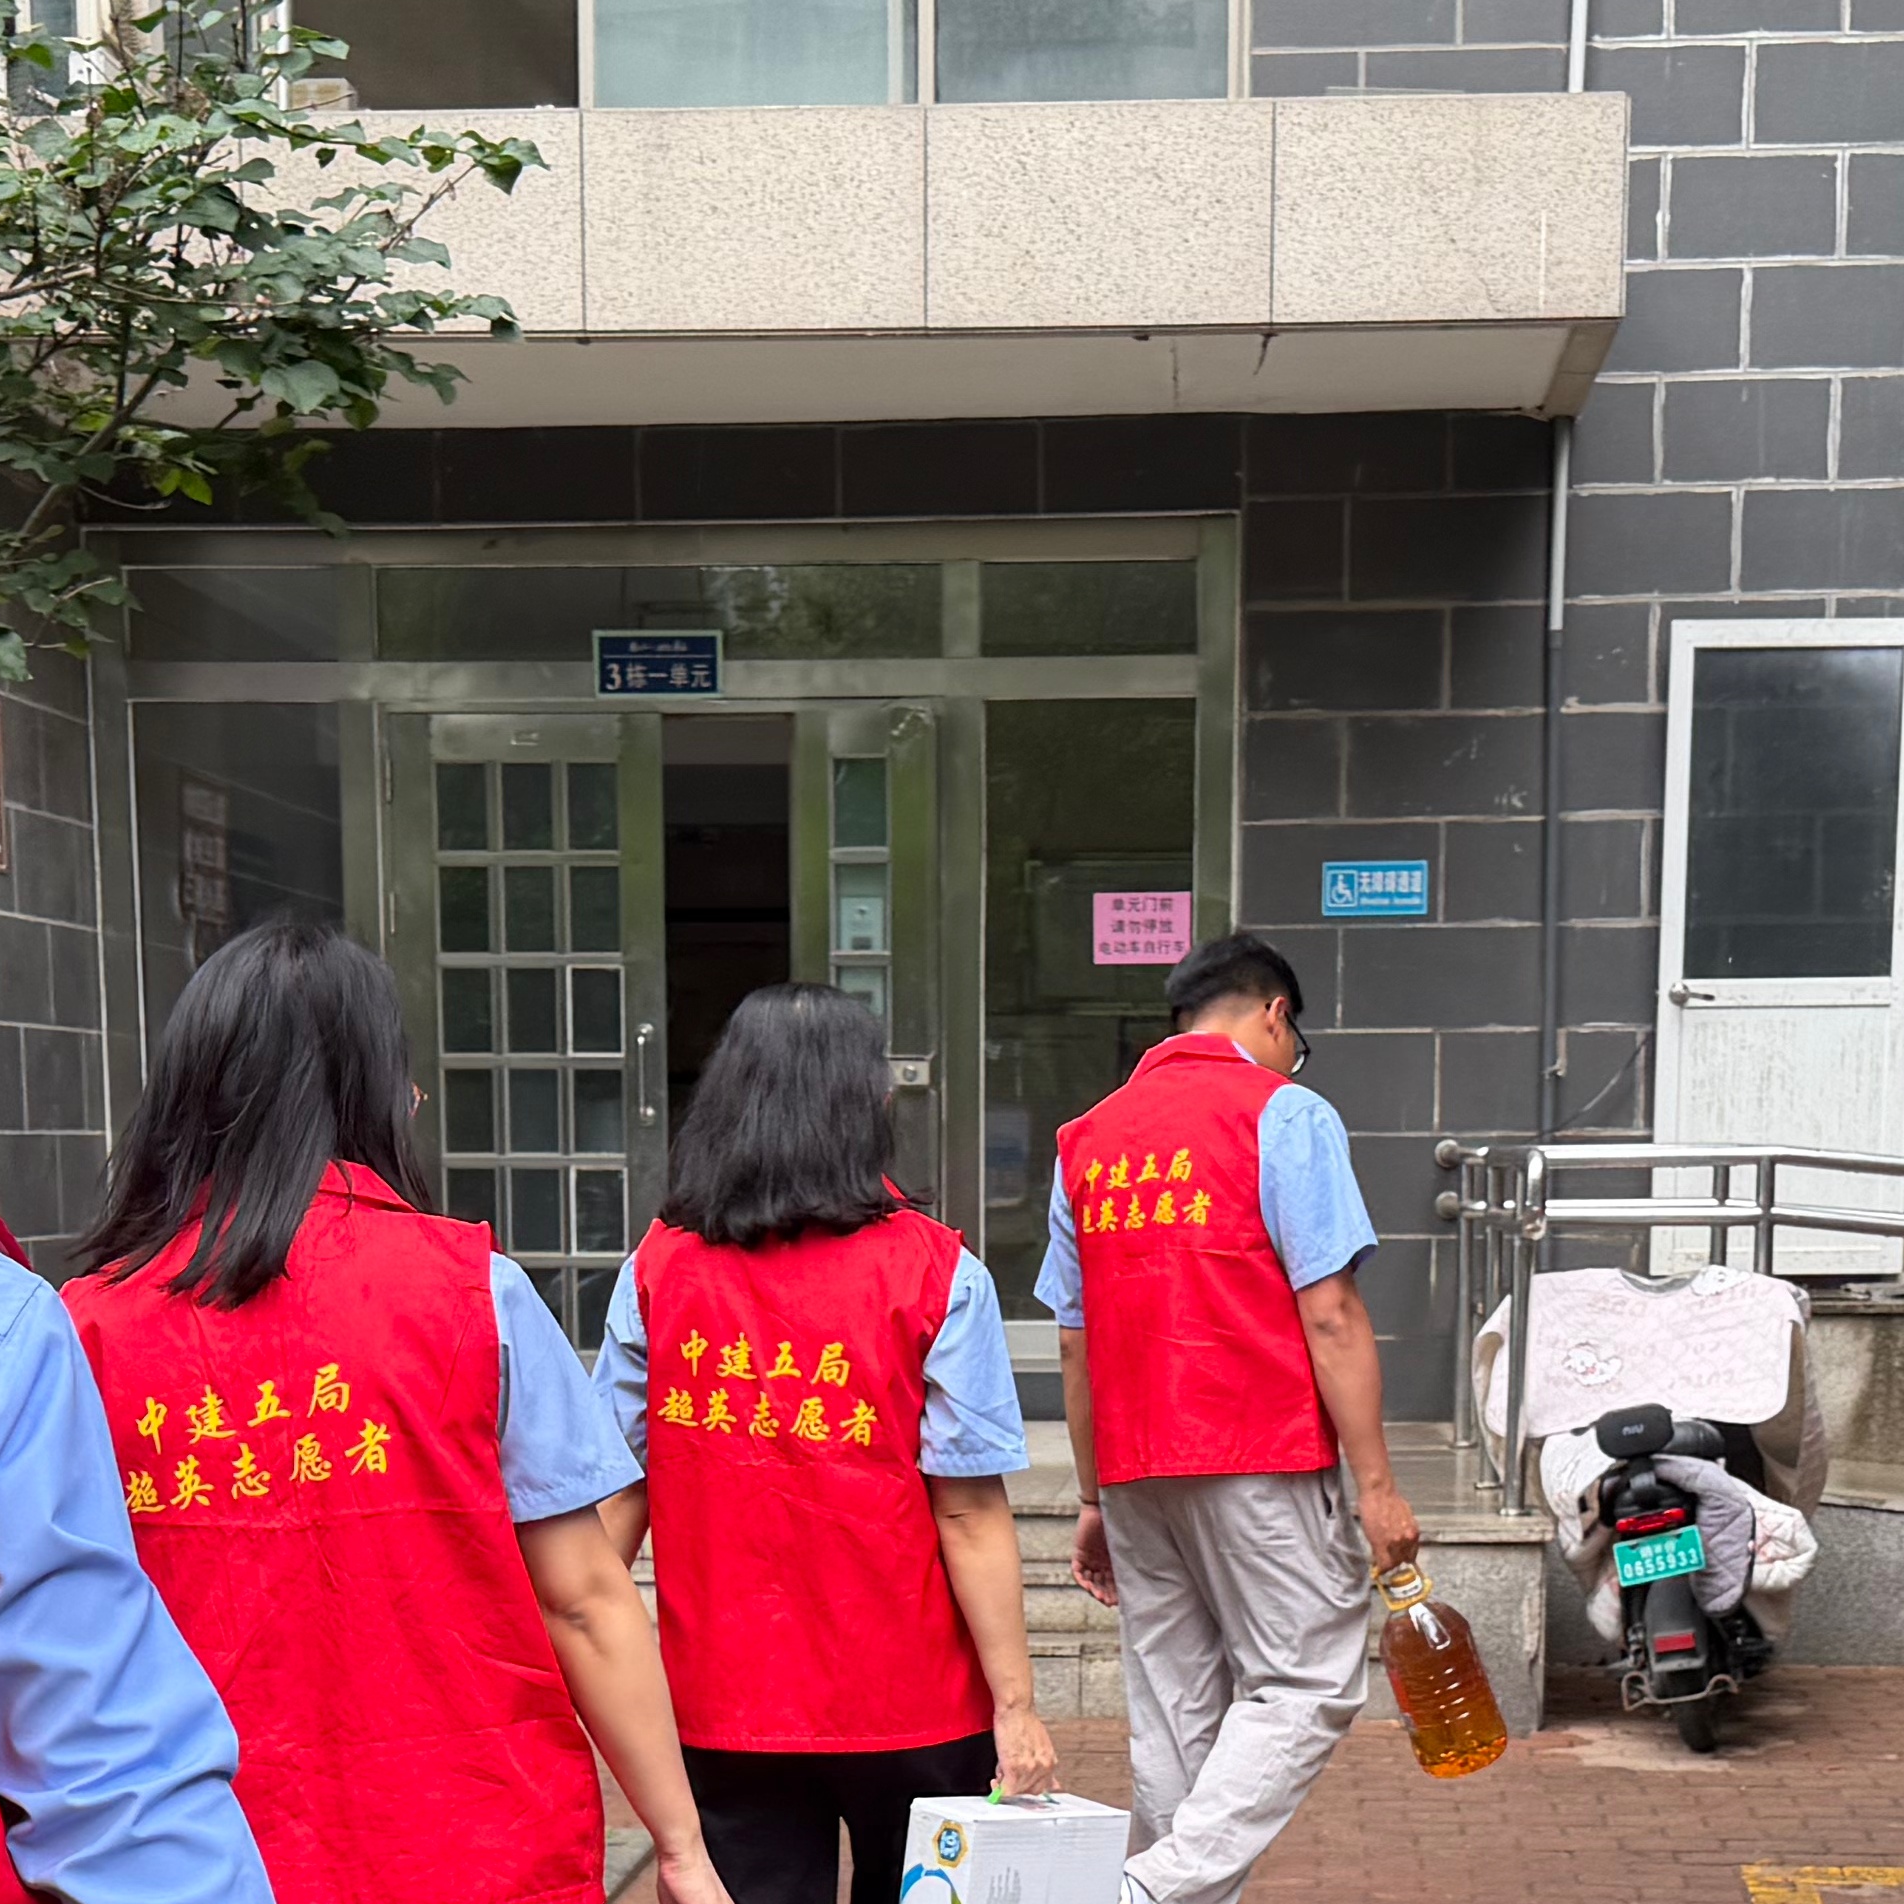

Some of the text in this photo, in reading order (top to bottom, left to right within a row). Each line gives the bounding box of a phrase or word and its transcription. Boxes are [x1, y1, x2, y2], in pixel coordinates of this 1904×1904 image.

[1084, 1148, 1194, 1192] 中建五局
[680, 1328, 852, 1388] 中建五局
[134, 1362, 351, 1456] 中建五局
[657, 1386, 879, 1447] 超英志愿者
[124, 1418, 392, 1515] 超英志愿者
